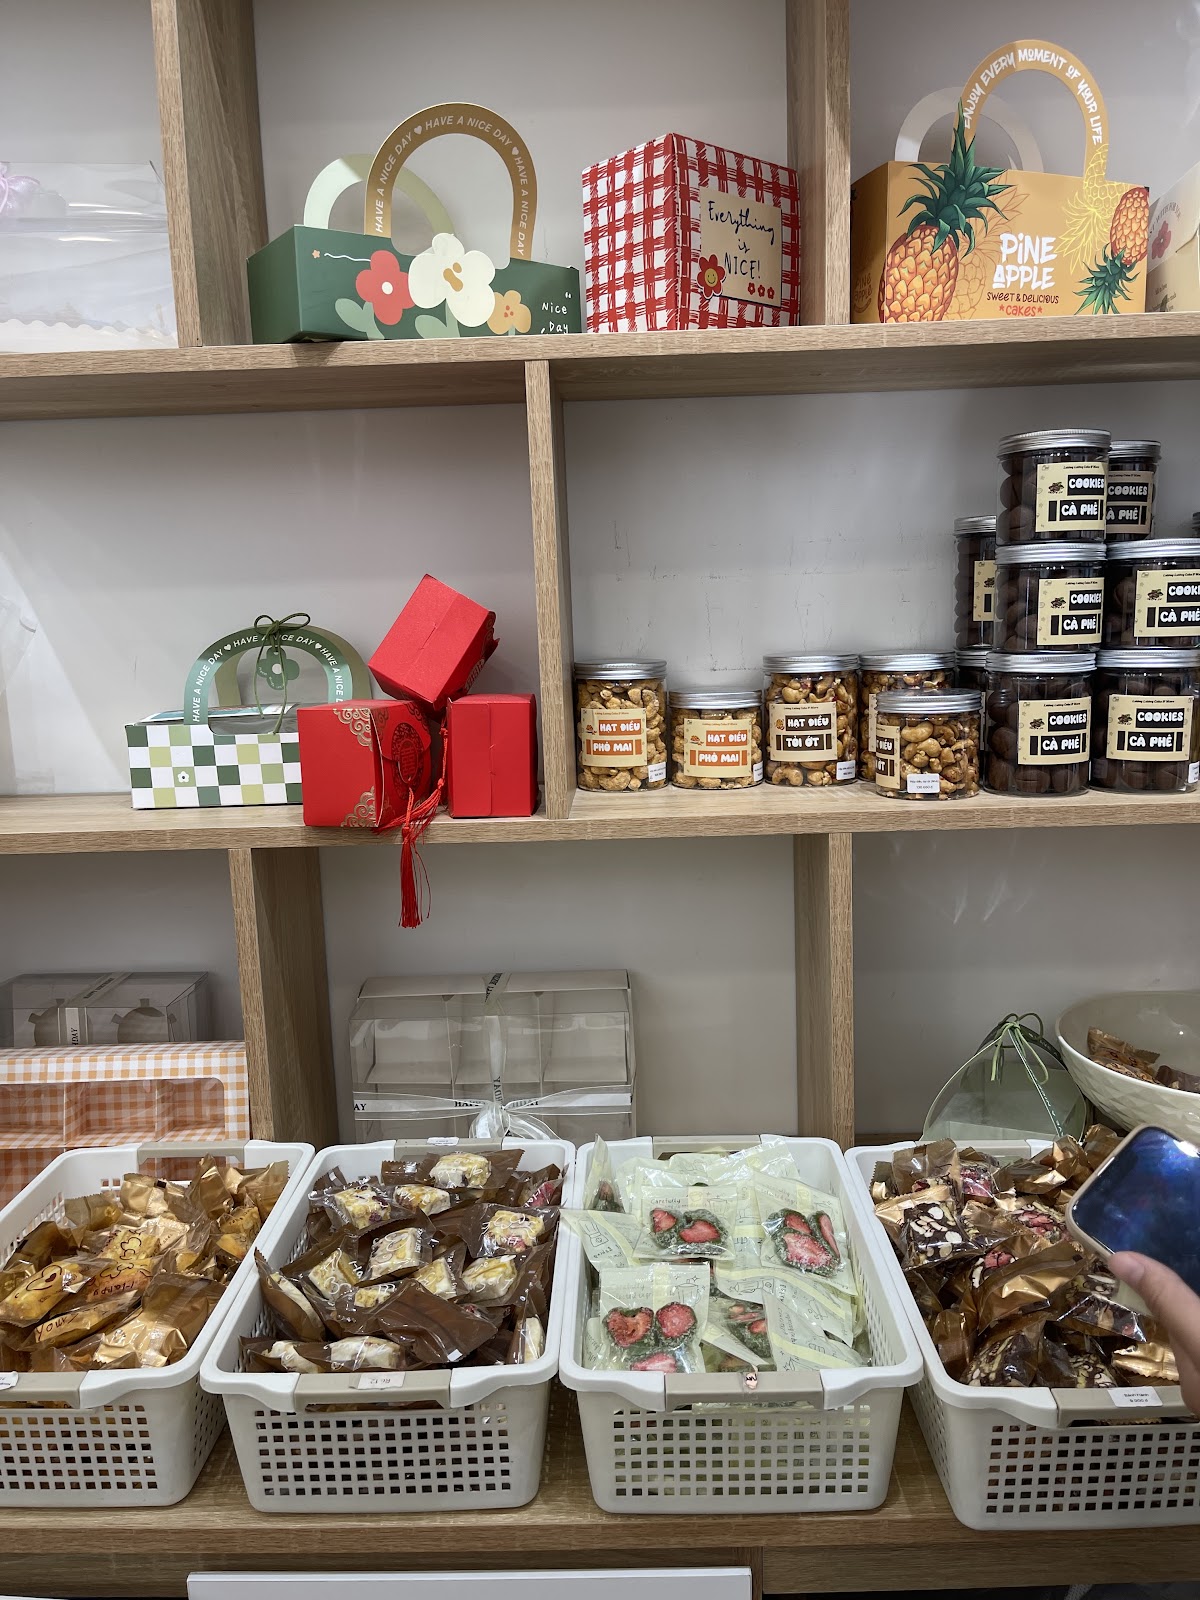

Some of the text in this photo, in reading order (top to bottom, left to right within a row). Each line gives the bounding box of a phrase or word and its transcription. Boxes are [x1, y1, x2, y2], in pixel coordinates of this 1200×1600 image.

[963, 49, 1102, 145] ENJOY EVERY MOMENT OF YOUR LIFE
[425, 116, 512, 146] HAVE A NICE DAY
[514, 156, 528, 186] HAVE
[375, 132, 412, 232] HAVE A NICE DAY
[518, 200, 528, 229] NICE
[708, 200, 774, 246] Everything
[518, 232, 526, 256] DAY
[738, 239, 750, 254] is
[724, 252, 760, 279] NICE!
[992, 264, 1055, 290] APPLE
[1016, 294, 1020, 302] &
[1068, 478, 1104, 488] COOKIES
[1108, 486, 1148, 496] COOKIES
[1061, 502, 1098, 516] CÀ PHÊ
[1106, 508, 1138, 520] À PHÊ
[1168, 585, 1200, 596] COOKI
[1070, 593, 1102, 604] COOKIES
[1160, 608, 1177, 622] CÀ
[1063, 616, 1078, 630] CÀ
[233, 636, 258, 648] HAVE
[296, 636, 315, 646] DAY
[208, 648, 224, 665] DAY
[195, 664, 210, 686] NICE
[320, 648, 338, 666] HAVE
[334, 676, 344, 696] NICE
[192, 696, 200, 722] HAVE
[787, 718, 806, 728] HẠT
[1049, 714, 1086, 726] COOKIES
[1137, 712, 1184, 722] COOKIES
[600, 723, 618, 733] HẠT
[707, 734, 726, 743] HẠT
[1042, 736, 1080, 750] CÀ PHÊ
[1129, 734, 1172, 748] CÀ PHÊ
[593, 742, 632, 752] PHÔ MAI
[698, 752, 738, 762] PHÔ MAI
